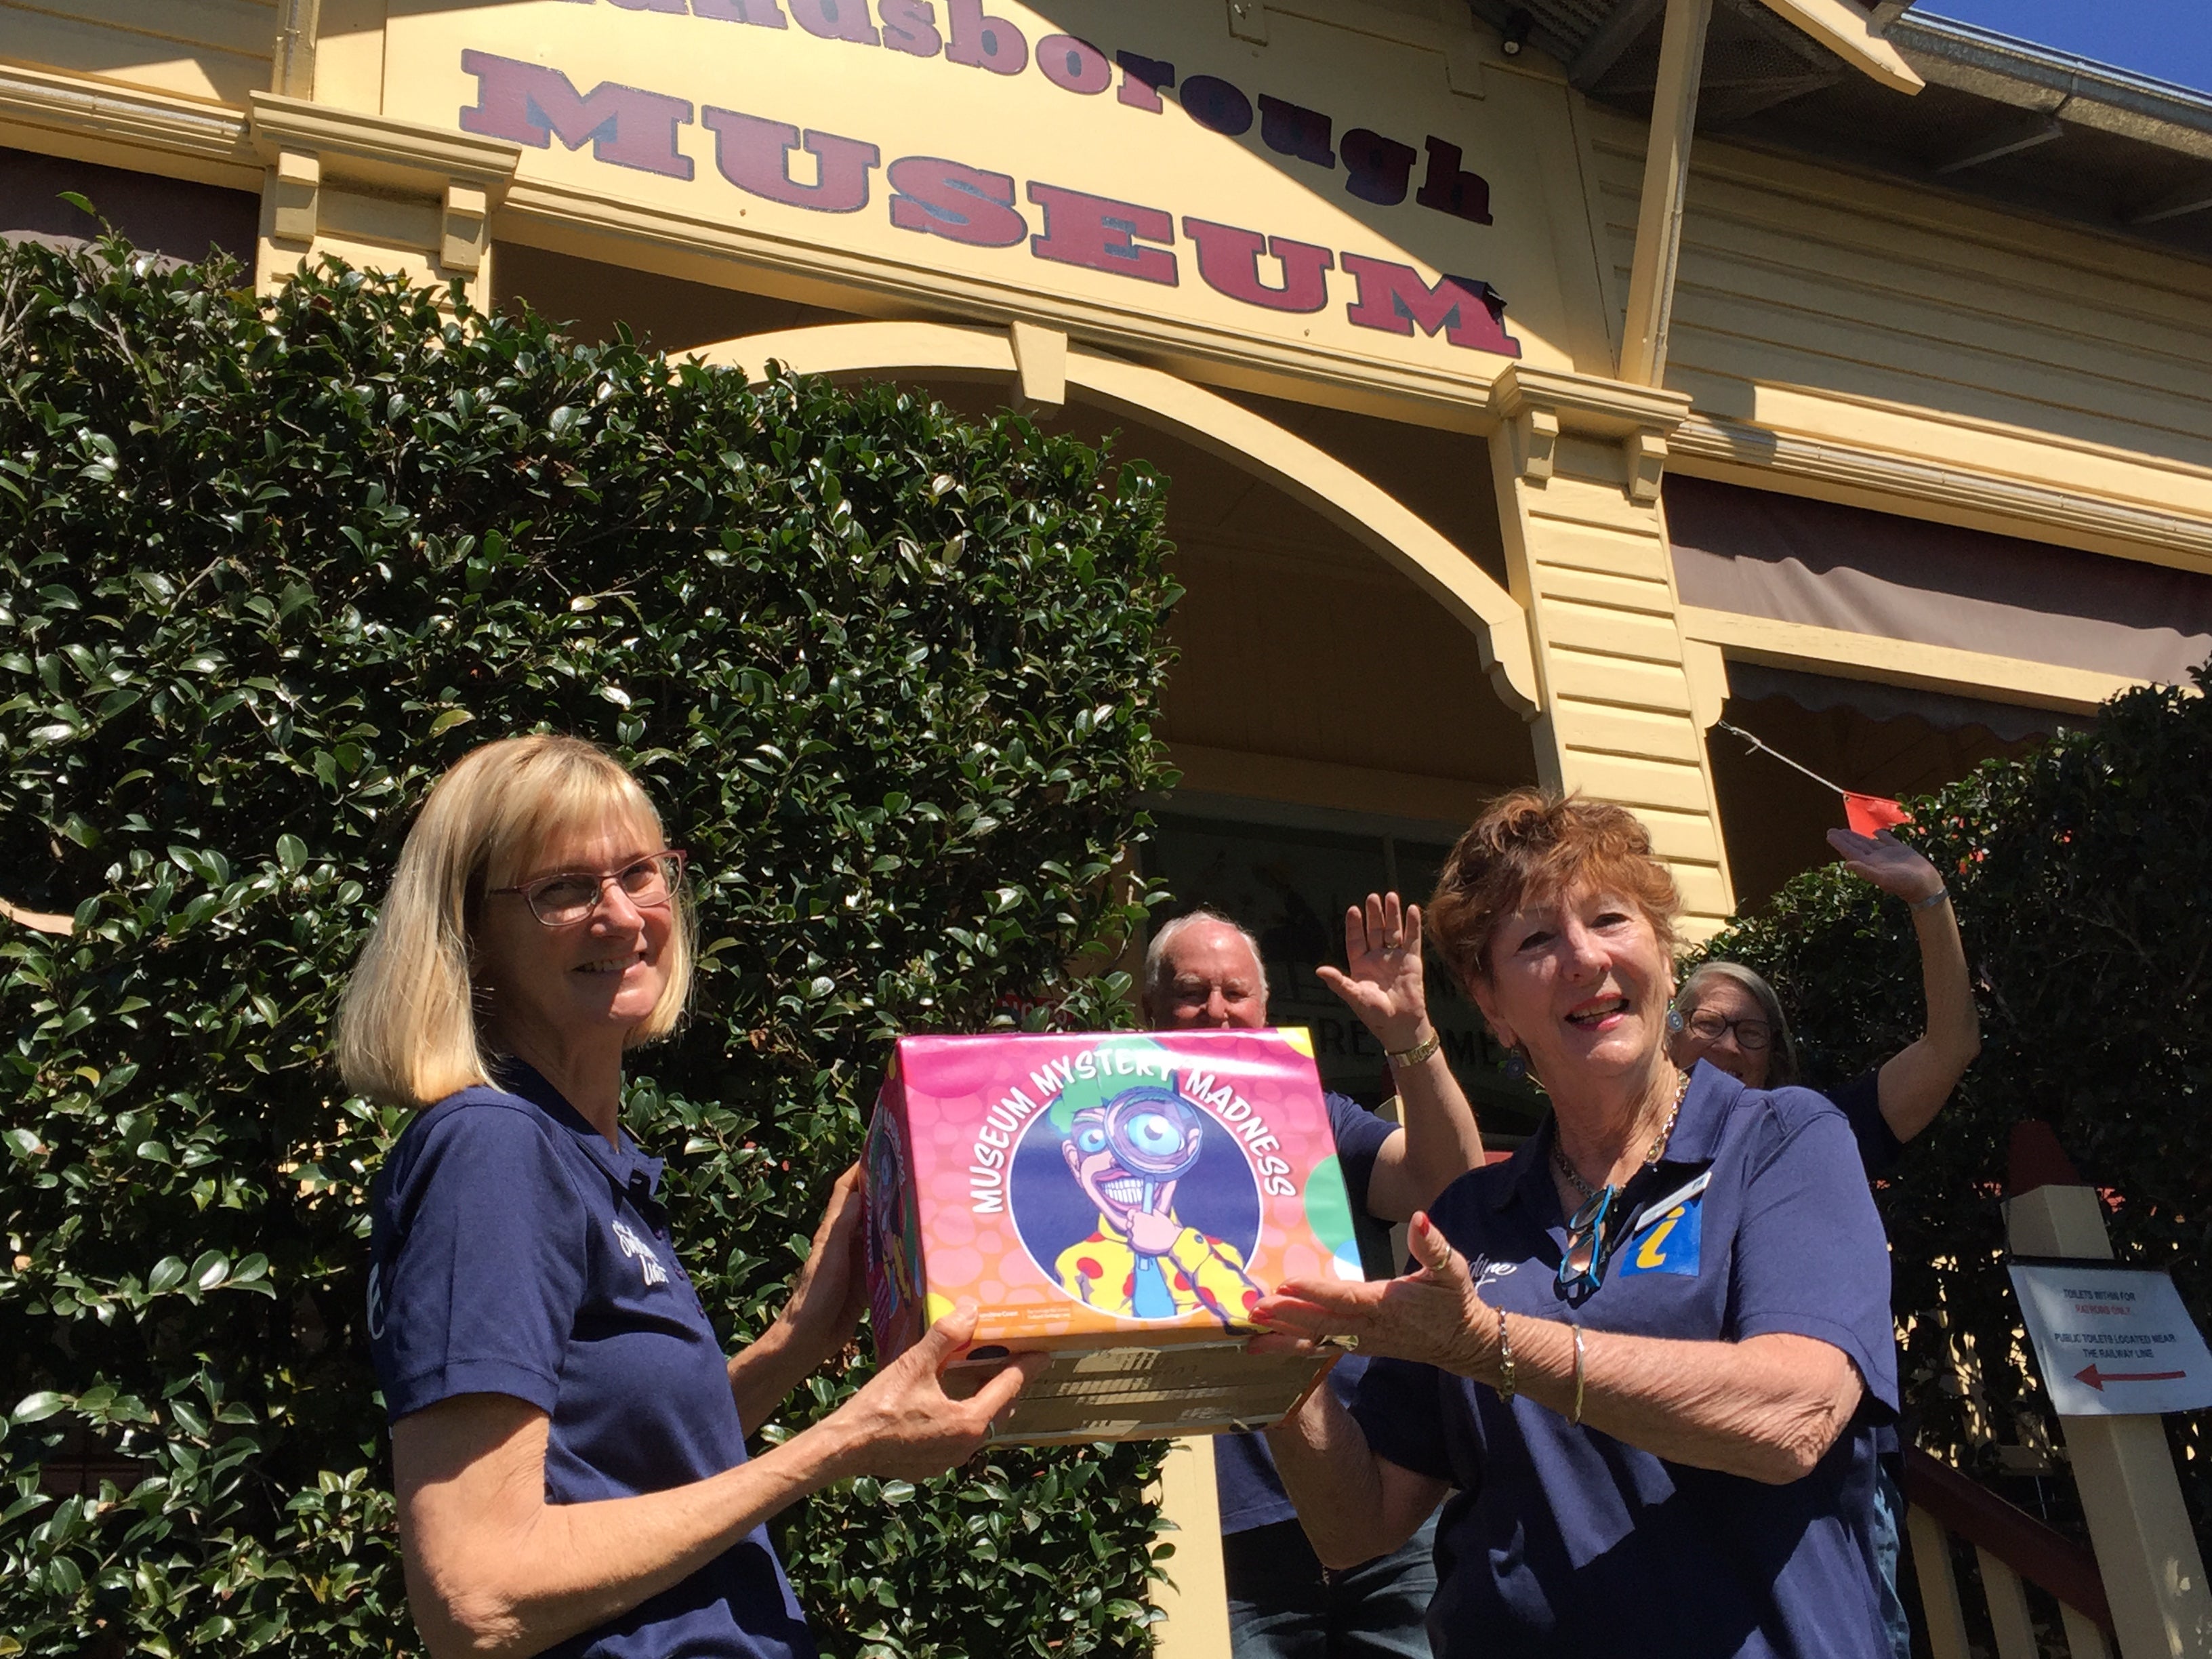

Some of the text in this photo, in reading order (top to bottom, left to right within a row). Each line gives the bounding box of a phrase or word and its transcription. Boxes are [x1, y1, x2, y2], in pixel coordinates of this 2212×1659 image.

[550, 0, 1493, 226] dsborough
[459, 48, 1522, 359] MUSEUM
[969, 1086, 1037, 1213] MUSEUM
[1029, 1048, 1178, 1097] MYSTERY
[1184, 1066, 1296, 1197] MADNESS
[2054, 1333, 2177, 1345] PUBLIC TOILETS LOCATED NEAR
[2063, 1289, 2136, 1301] TOILETS WITHIN FOR
[2083, 1349, 2154, 1359] THE RAILWAY LINE
